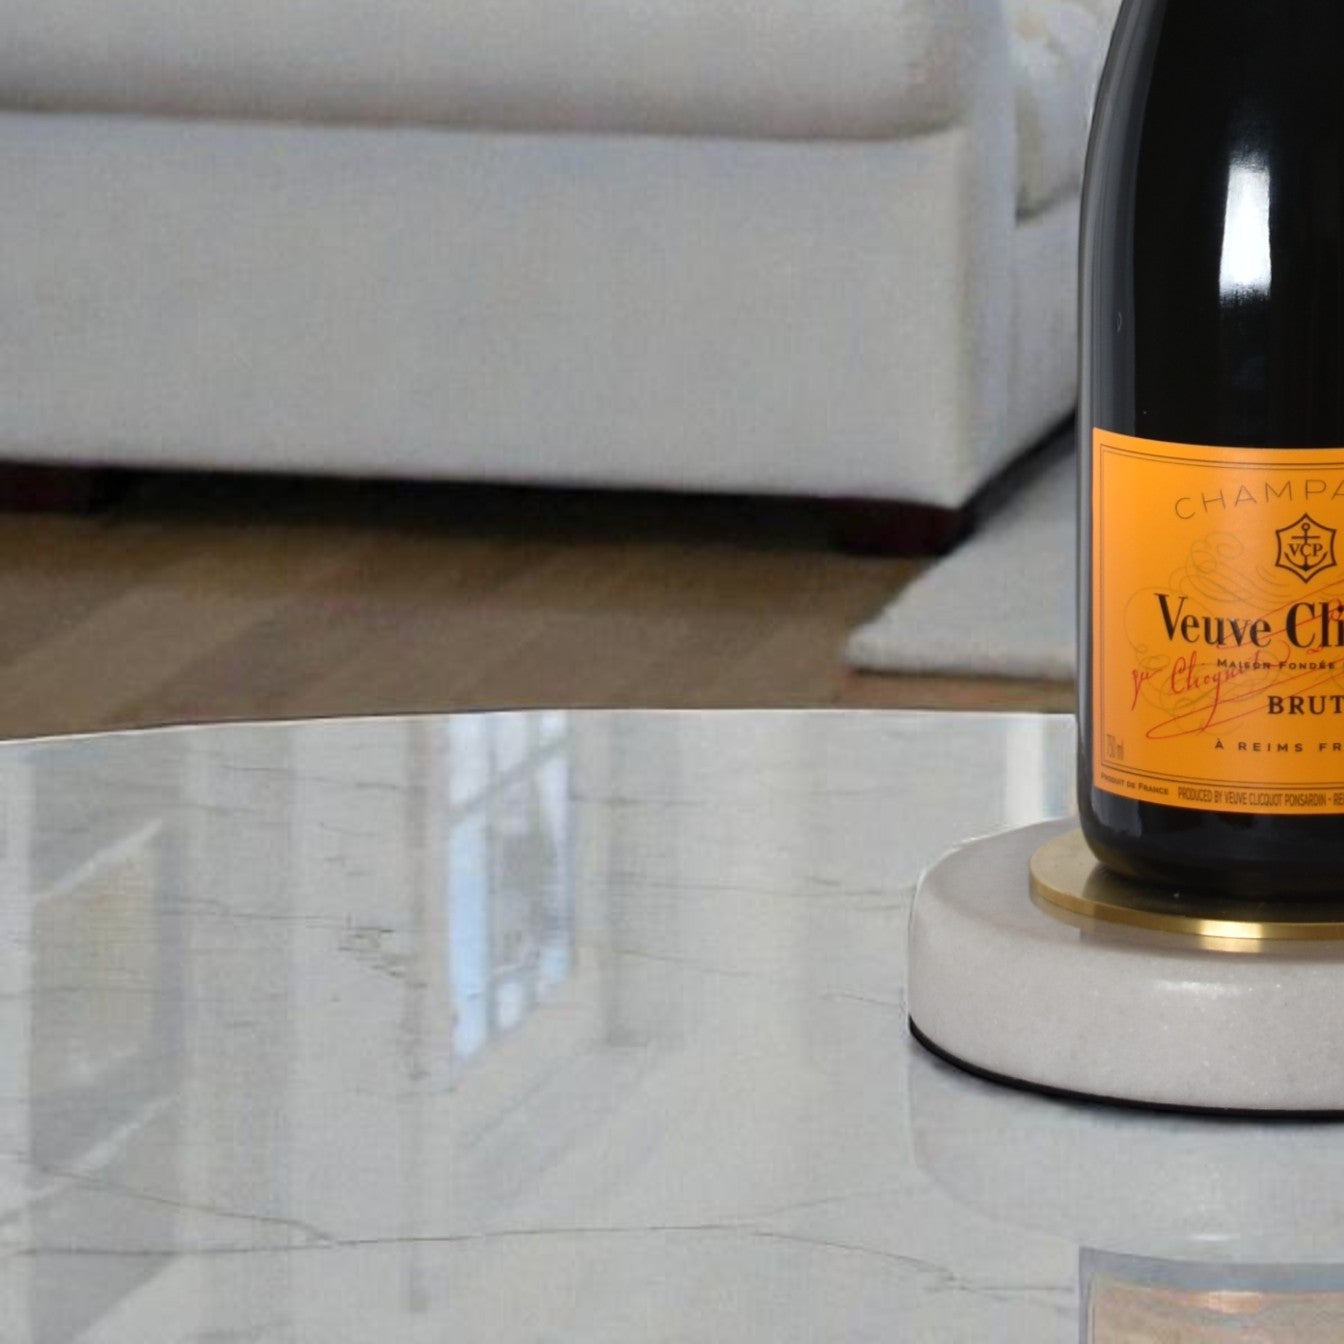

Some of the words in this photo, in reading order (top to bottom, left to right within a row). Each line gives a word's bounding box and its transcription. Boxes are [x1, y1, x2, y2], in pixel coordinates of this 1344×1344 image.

[1154, 592, 1272, 648] Veuve
[1214, 737, 1224, 750] À
[1238, 741, 1304, 752] REIMS
[1177, 786, 1213, 803] PRODUCED
[1224, 791, 1248, 806] VEUVE
[1249, 792, 1283, 807] CLICQUOT
[1284, 793, 1327, 807] PONSARDIN
